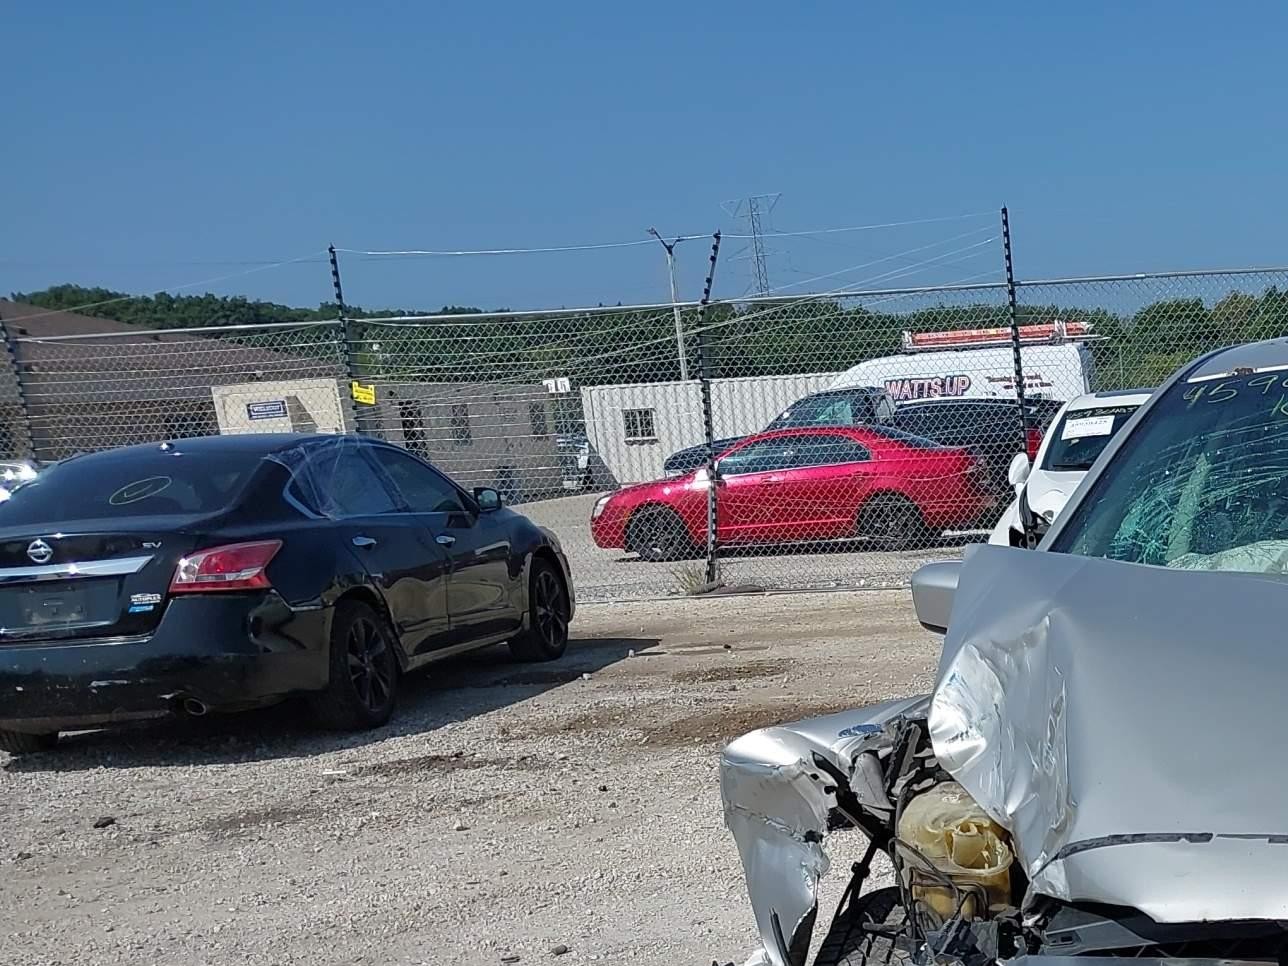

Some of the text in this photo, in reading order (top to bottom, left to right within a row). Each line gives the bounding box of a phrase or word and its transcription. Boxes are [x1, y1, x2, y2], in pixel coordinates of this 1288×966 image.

[885, 374, 970, 400] WATTS UP
[142, 541, 162, 549] SV
